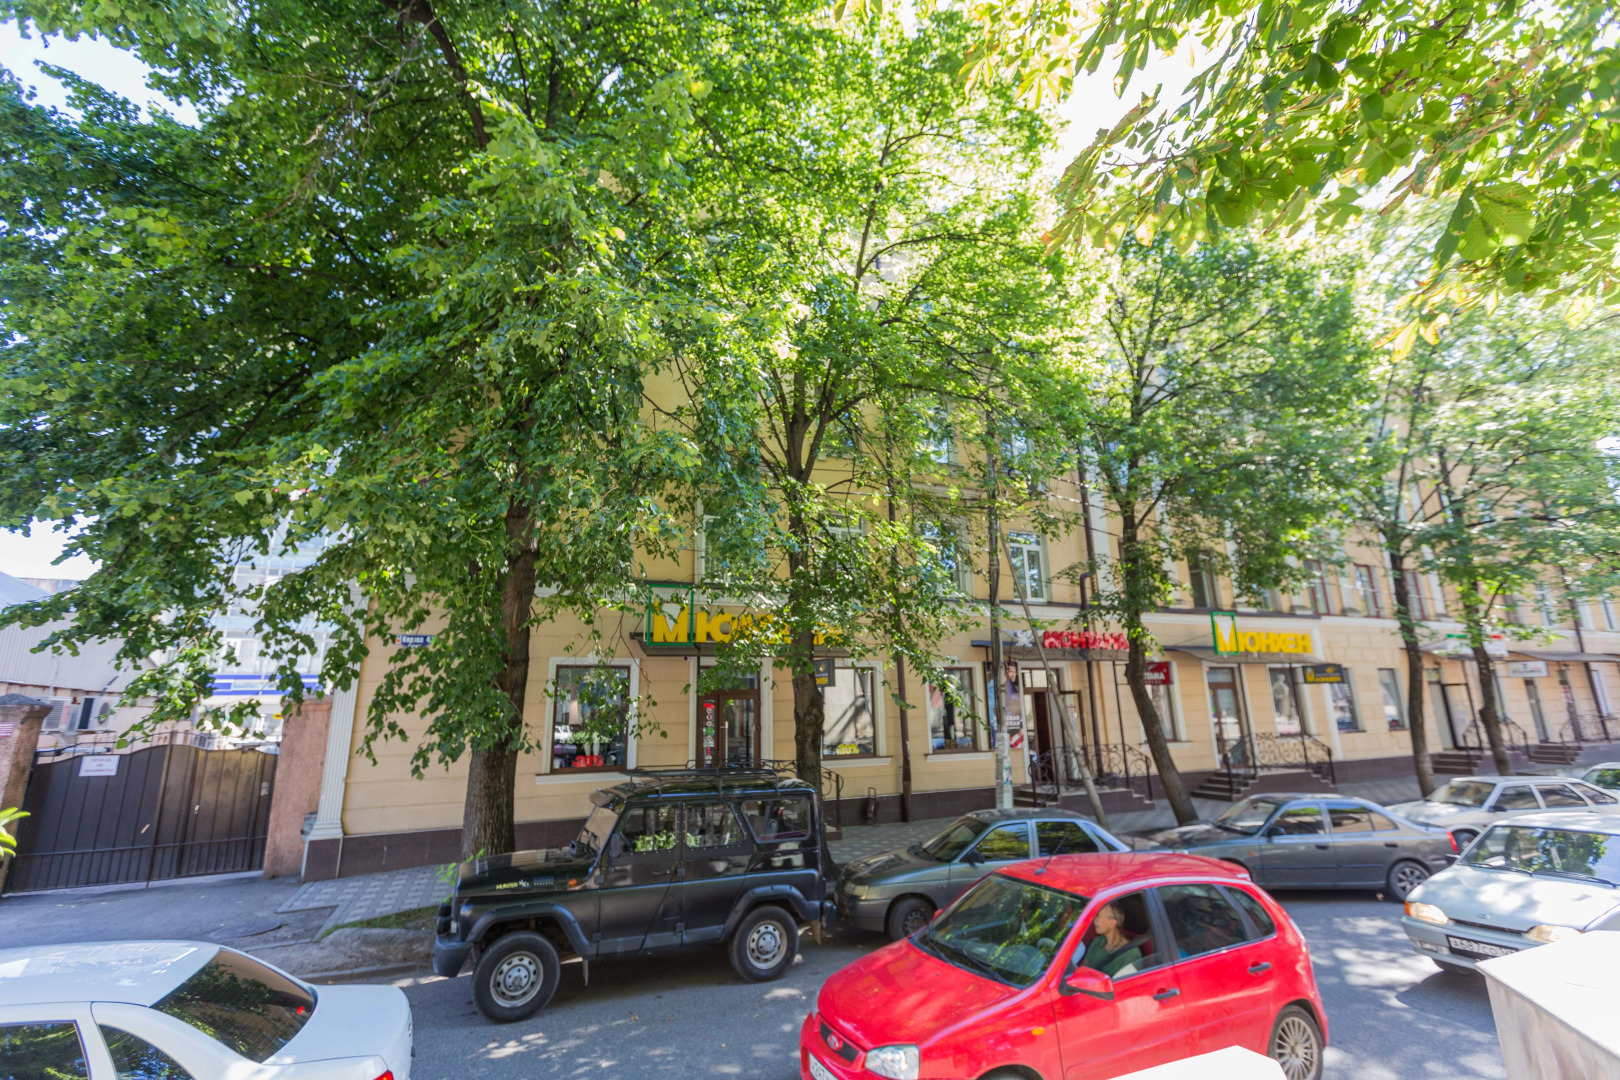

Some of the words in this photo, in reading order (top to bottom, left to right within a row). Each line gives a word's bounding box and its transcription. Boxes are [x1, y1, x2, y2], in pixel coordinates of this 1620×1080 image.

[1043, 630, 1129, 650] МОНТАНА
[1215, 620, 1312, 653] МЮНХЕН
[1144, 671, 1166, 681] TANA
[495, 882, 518, 890] HUNTER
